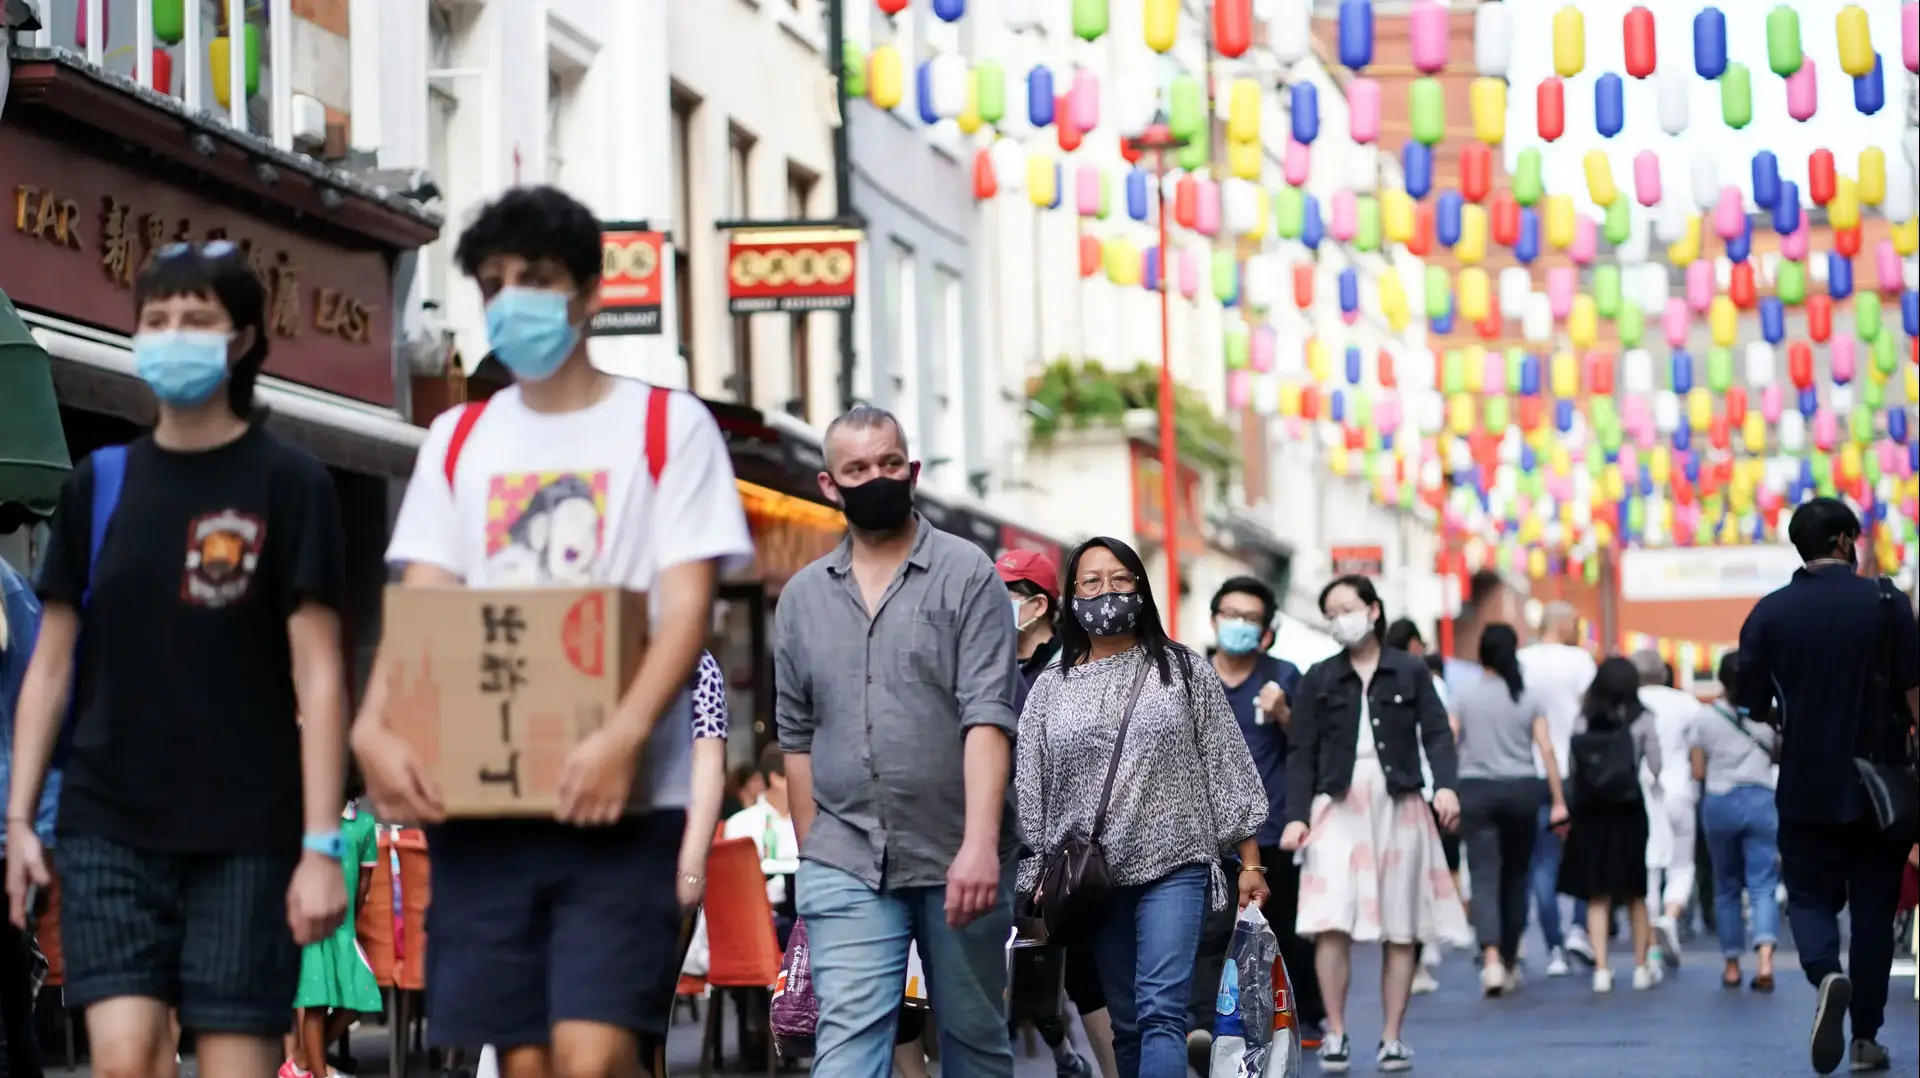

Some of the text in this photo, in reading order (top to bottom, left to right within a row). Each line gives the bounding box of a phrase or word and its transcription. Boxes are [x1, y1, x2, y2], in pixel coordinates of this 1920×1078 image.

[15, 184, 379, 343] FAR EAST
[478, 604, 526, 799] 出前一丁
[787, 945, 802, 992] Sainsbury's
